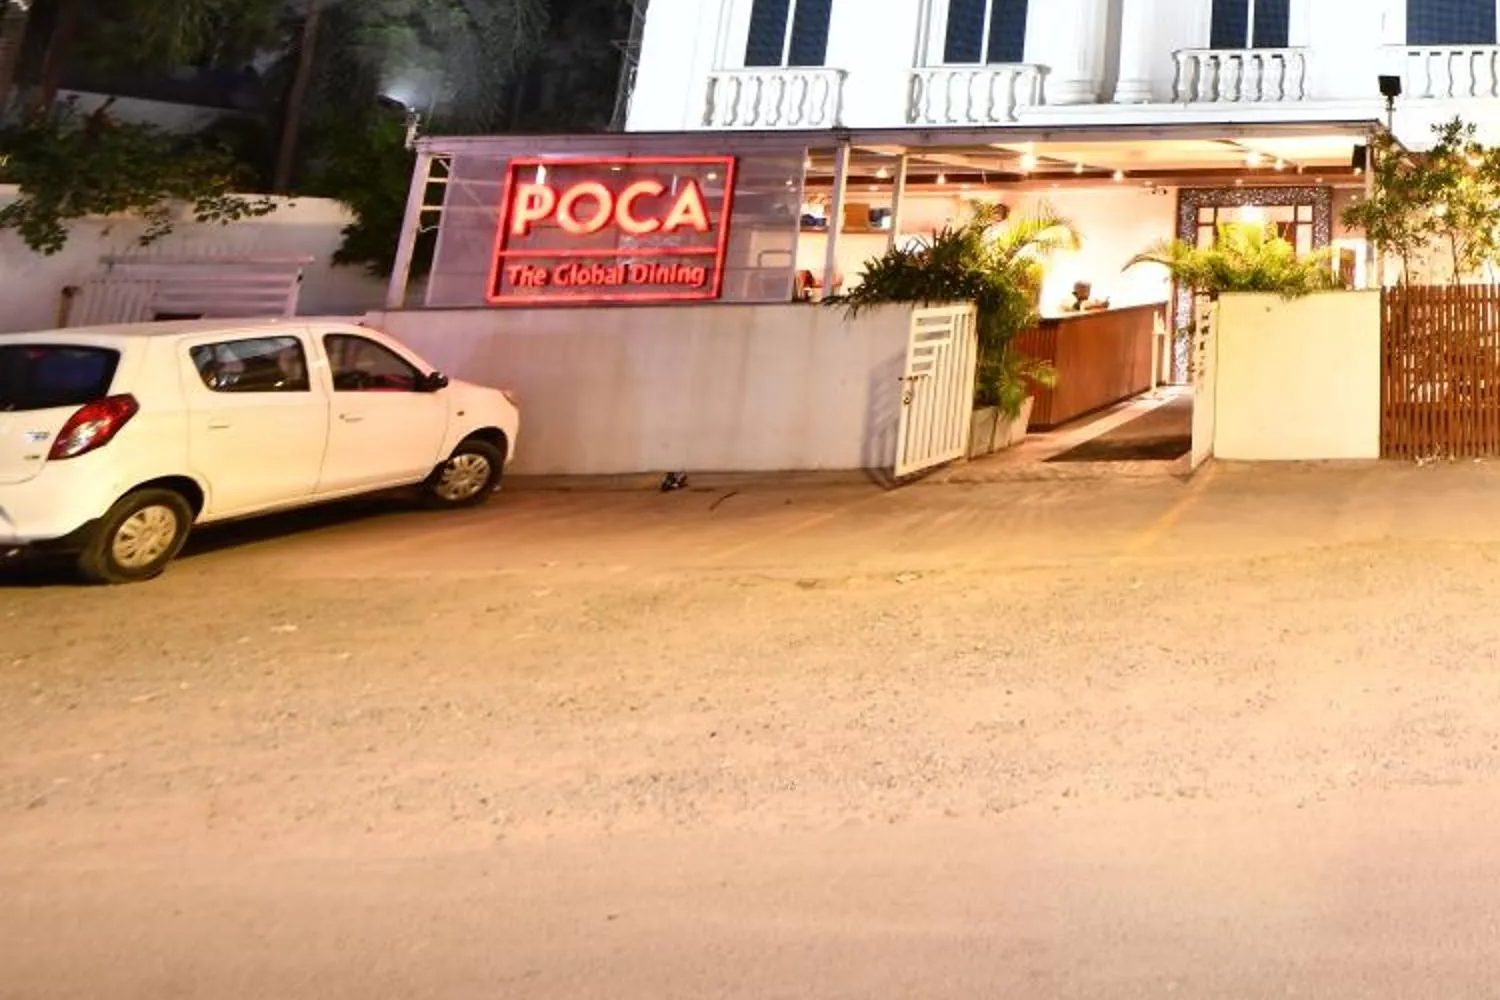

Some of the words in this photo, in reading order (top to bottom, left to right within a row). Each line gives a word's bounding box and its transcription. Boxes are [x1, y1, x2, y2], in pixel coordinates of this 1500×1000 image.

[509, 179, 712, 237] POCA
[508, 264, 547, 287] The
[553, 263, 626, 285] Global
[630, 262, 706, 288] Dining
